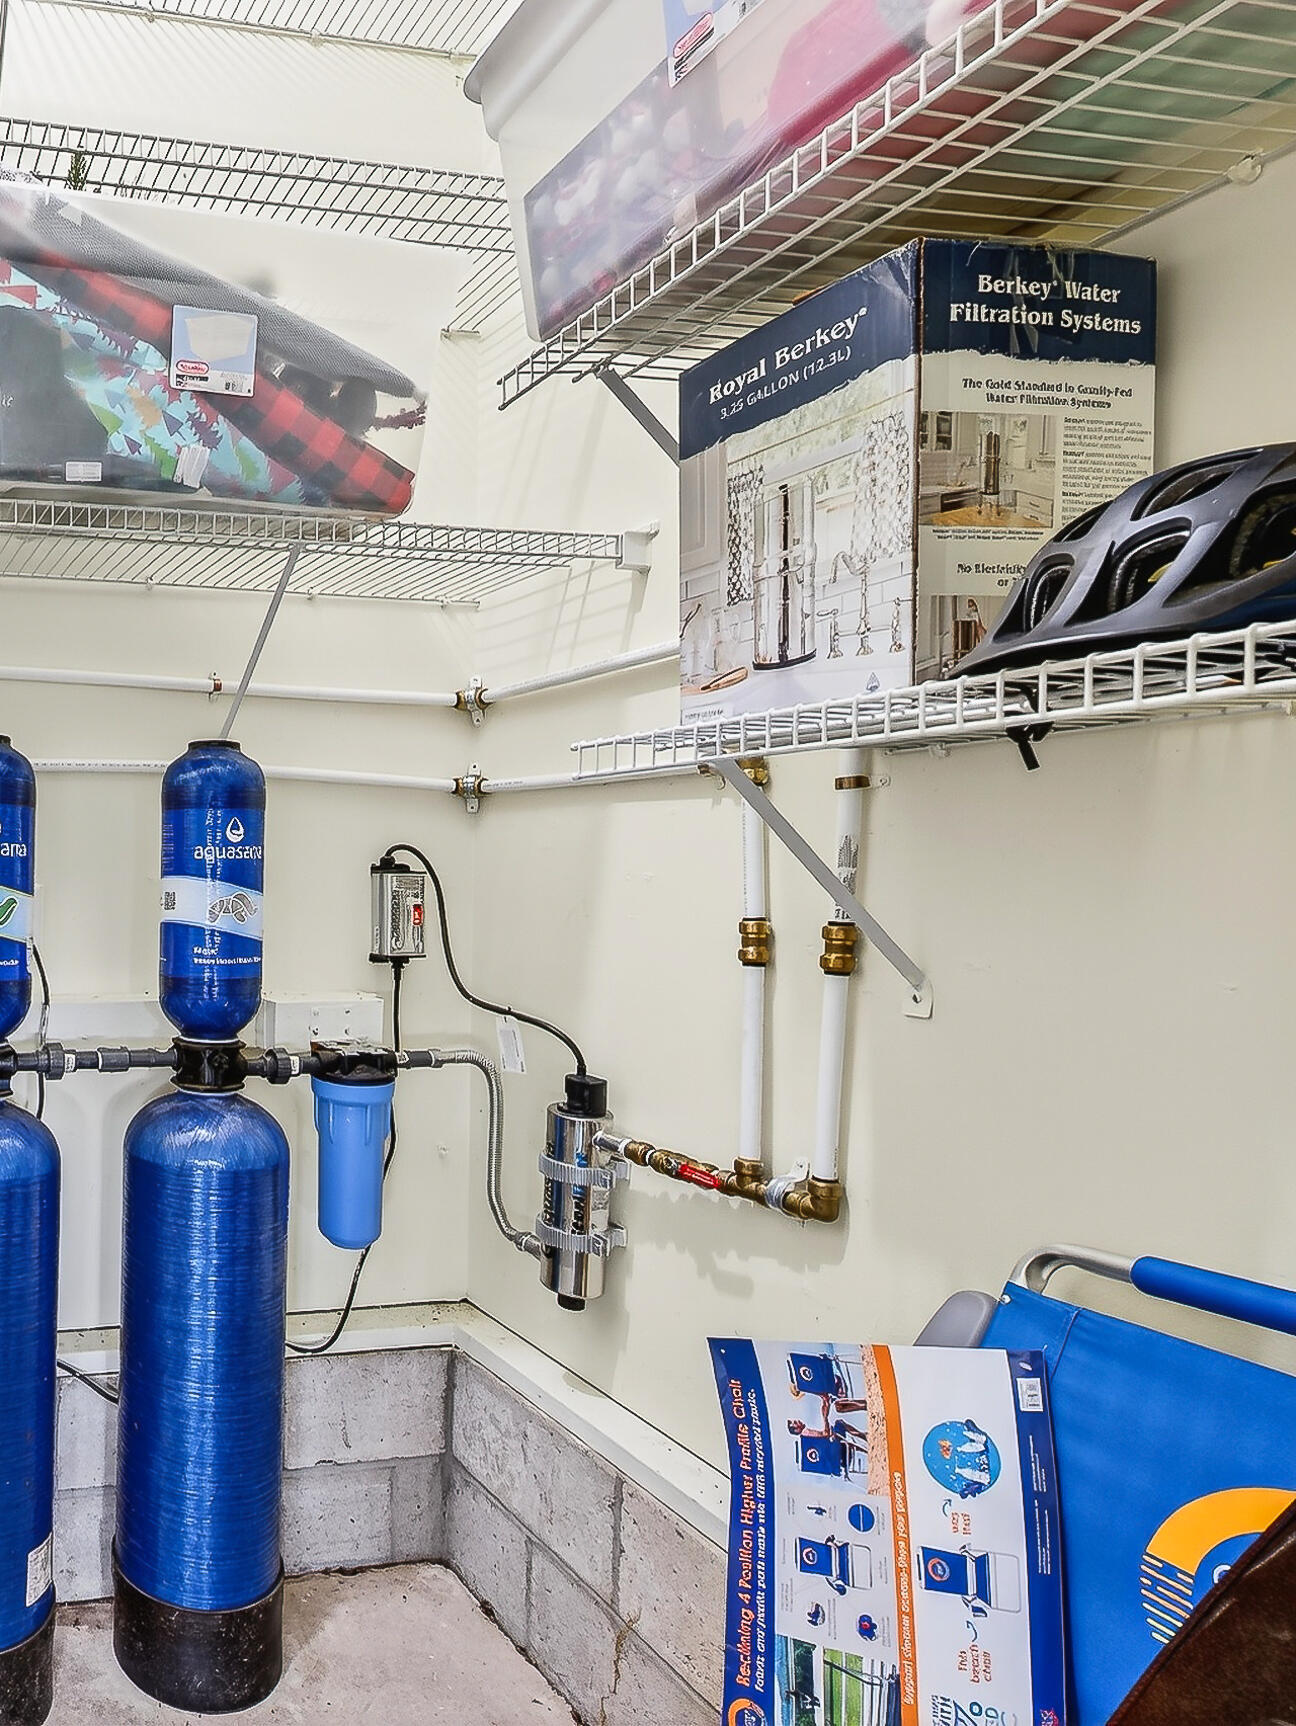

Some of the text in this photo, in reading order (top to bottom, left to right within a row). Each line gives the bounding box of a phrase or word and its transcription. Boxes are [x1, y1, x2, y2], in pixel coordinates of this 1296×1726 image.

[1065, 280, 1121, 303] Water
[949, 301, 1142, 334] Filtration Systems
[708, 358, 767, 405] Royal
[747, 369, 800, 407] GALLON
[962, 378, 982, 389] The
[985, 379, 1011, 390] Gold
[729, 1379, 746, 1419] Chair
[738, 1423, 752, 1470] Profile
[740, 1474, 756, 1525] Higher
[738, 1529, 754, 1589] Position
[735, 1608, 755, 1687] Reclining
